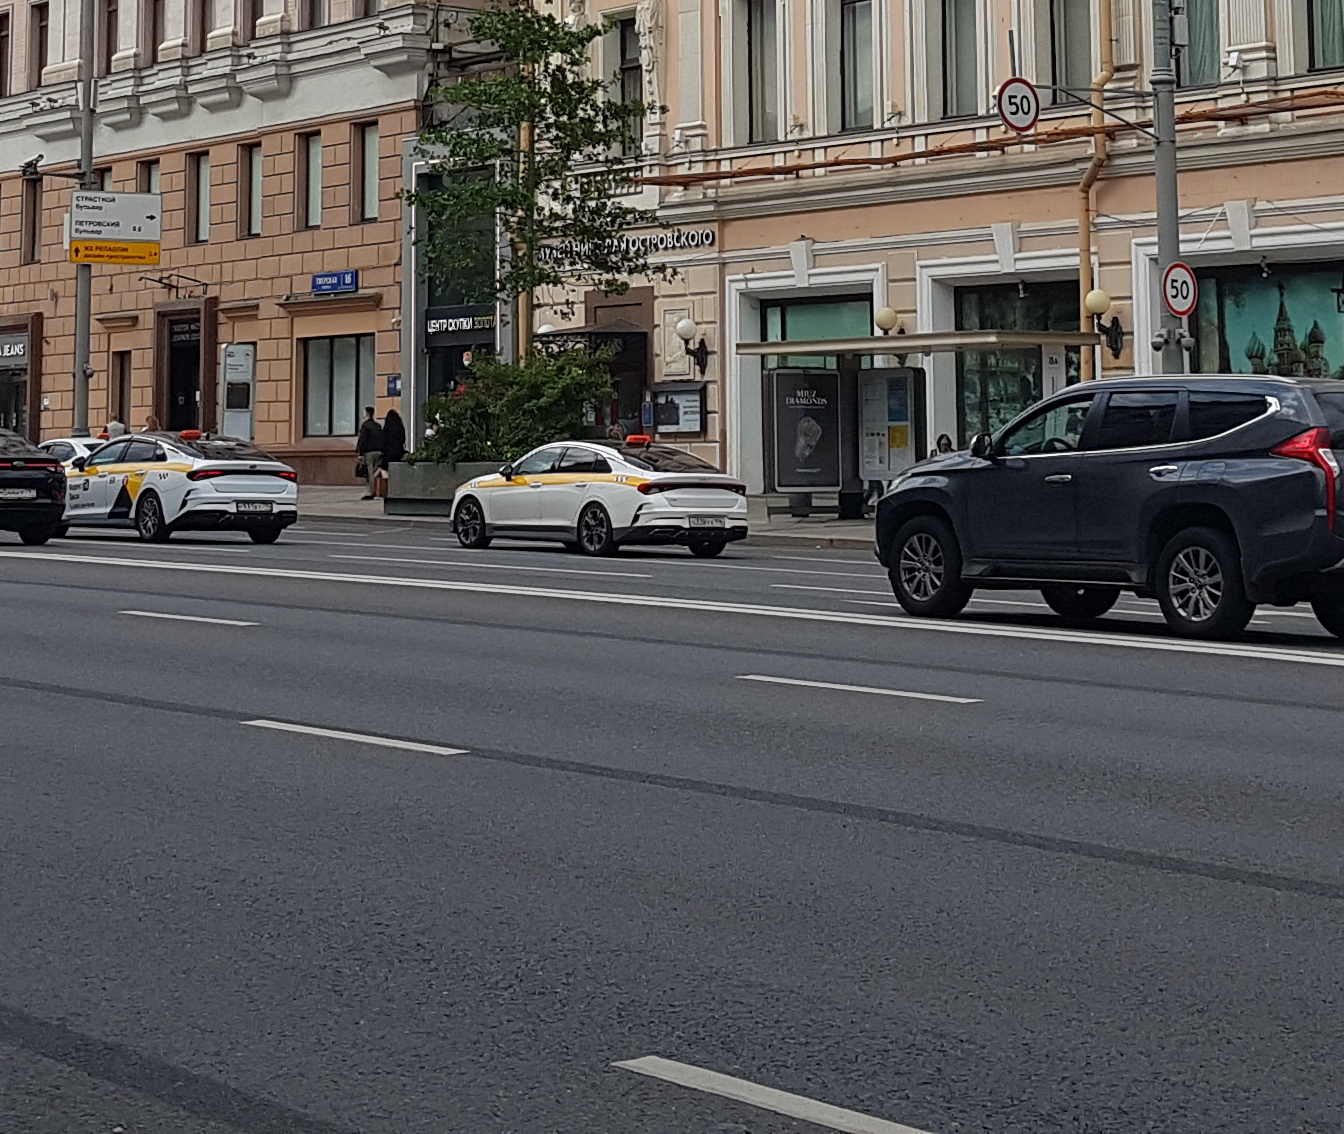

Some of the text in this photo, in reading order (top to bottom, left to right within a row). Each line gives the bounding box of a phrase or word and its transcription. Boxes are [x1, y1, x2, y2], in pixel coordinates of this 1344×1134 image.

[1008, 95, 1031, 116] 50
[629, 229, 713, 251] ОСТРОВСКОГО
[1170, 278, 1190, 300] 50
[3, 343, 24, 356] JEANS
[785, 397, 828, 405] DIAMONDS
